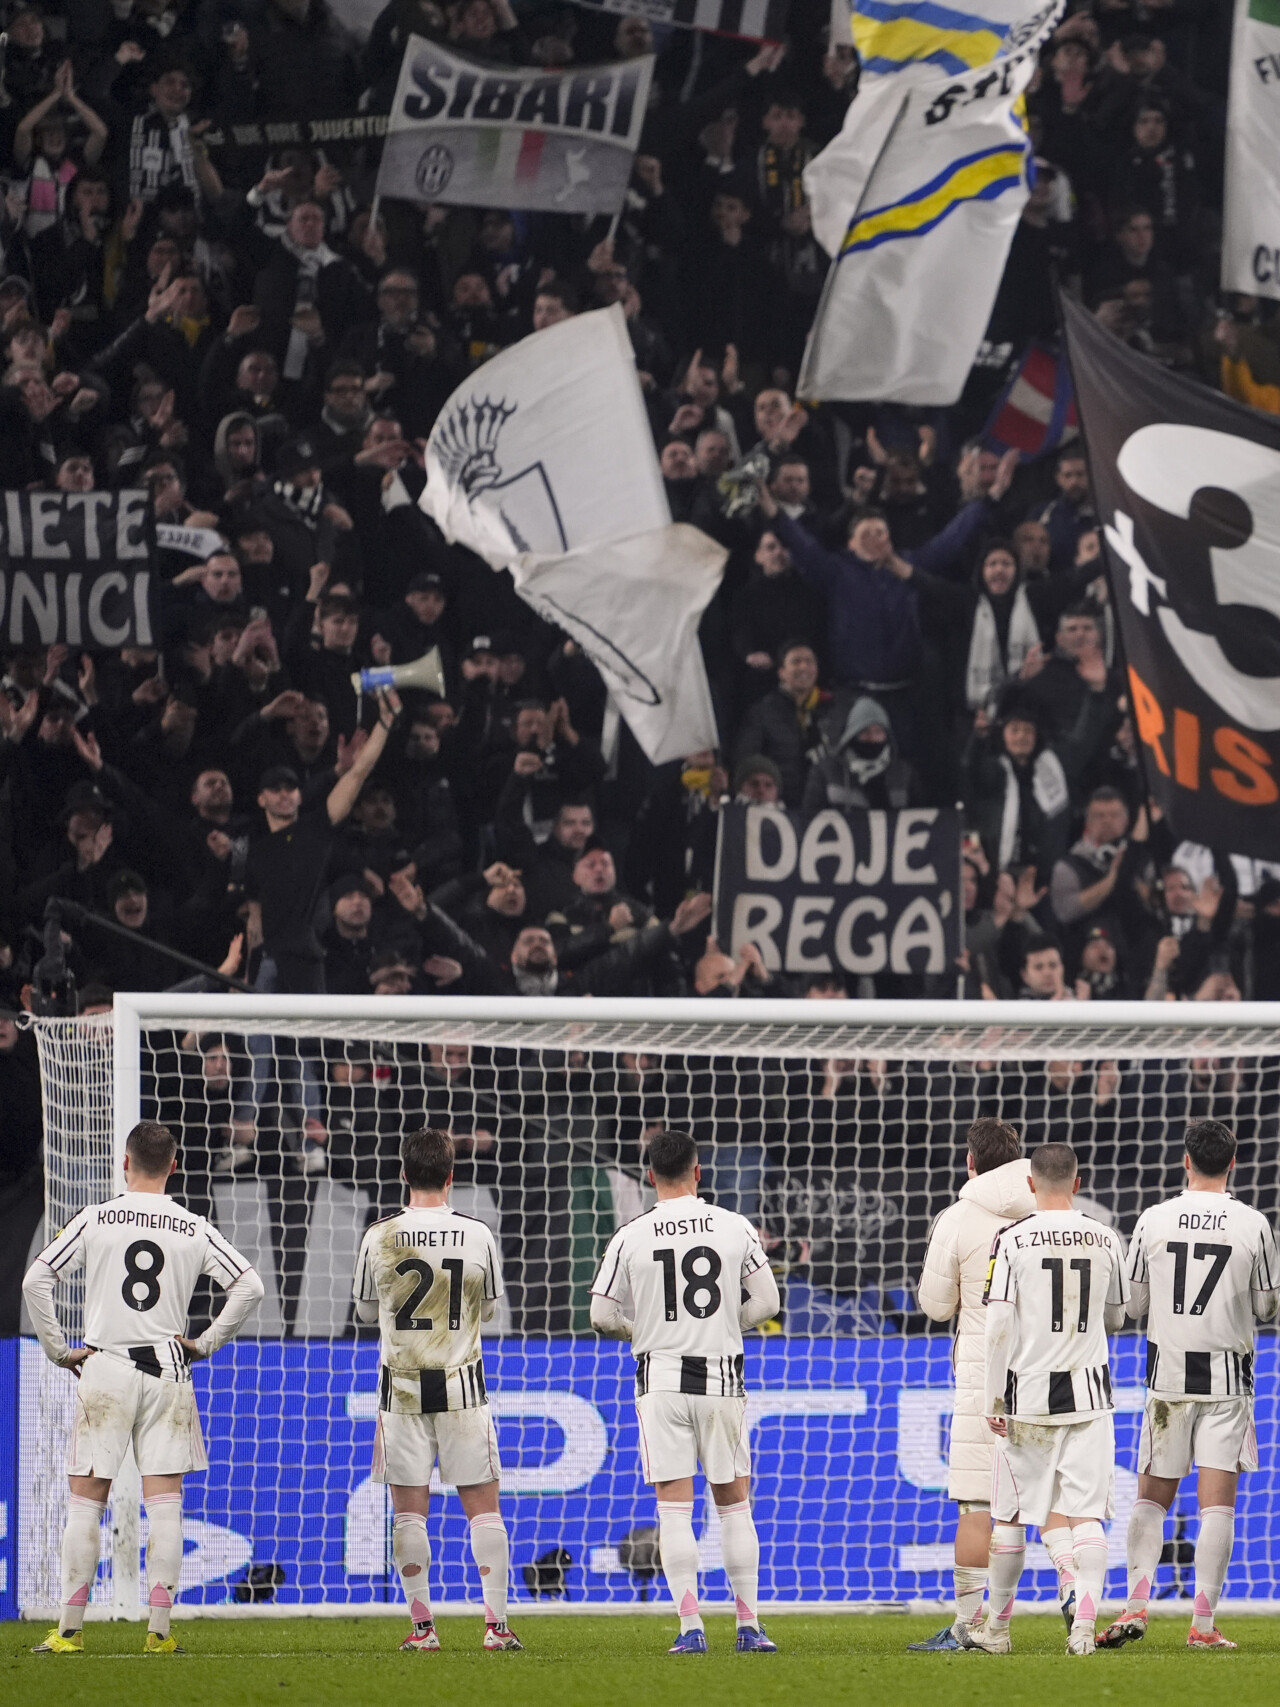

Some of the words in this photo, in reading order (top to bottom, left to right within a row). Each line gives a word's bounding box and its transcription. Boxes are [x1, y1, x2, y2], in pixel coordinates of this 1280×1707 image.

[309, 114, 391, 142] JUVENTU
[404, 52, 641, 139] SIBARI
[0, 488, 150, 560] IETE
[0, 570, 153, 647] NICI
[745, 806, 939, 886] DAJE
[731, 889, 953, 974] REGA'
[97, 1208, 197, 1238] KOOPMEINERS
[395, 1230, 466, 1248] MIRETTI
[653, 1213, 715, 1238] KOSTIĆ
[1178, 1213, 1228, 1231] ADŽIĆ
[121, 1239, 165, 1312] 8
[395, 1258, 464, 1331] 21
[653, 1245, 722, 1322] 18
[1041, 1258, 1091, 1333] 11
[1166, 1241, 1233, 1316] 17
